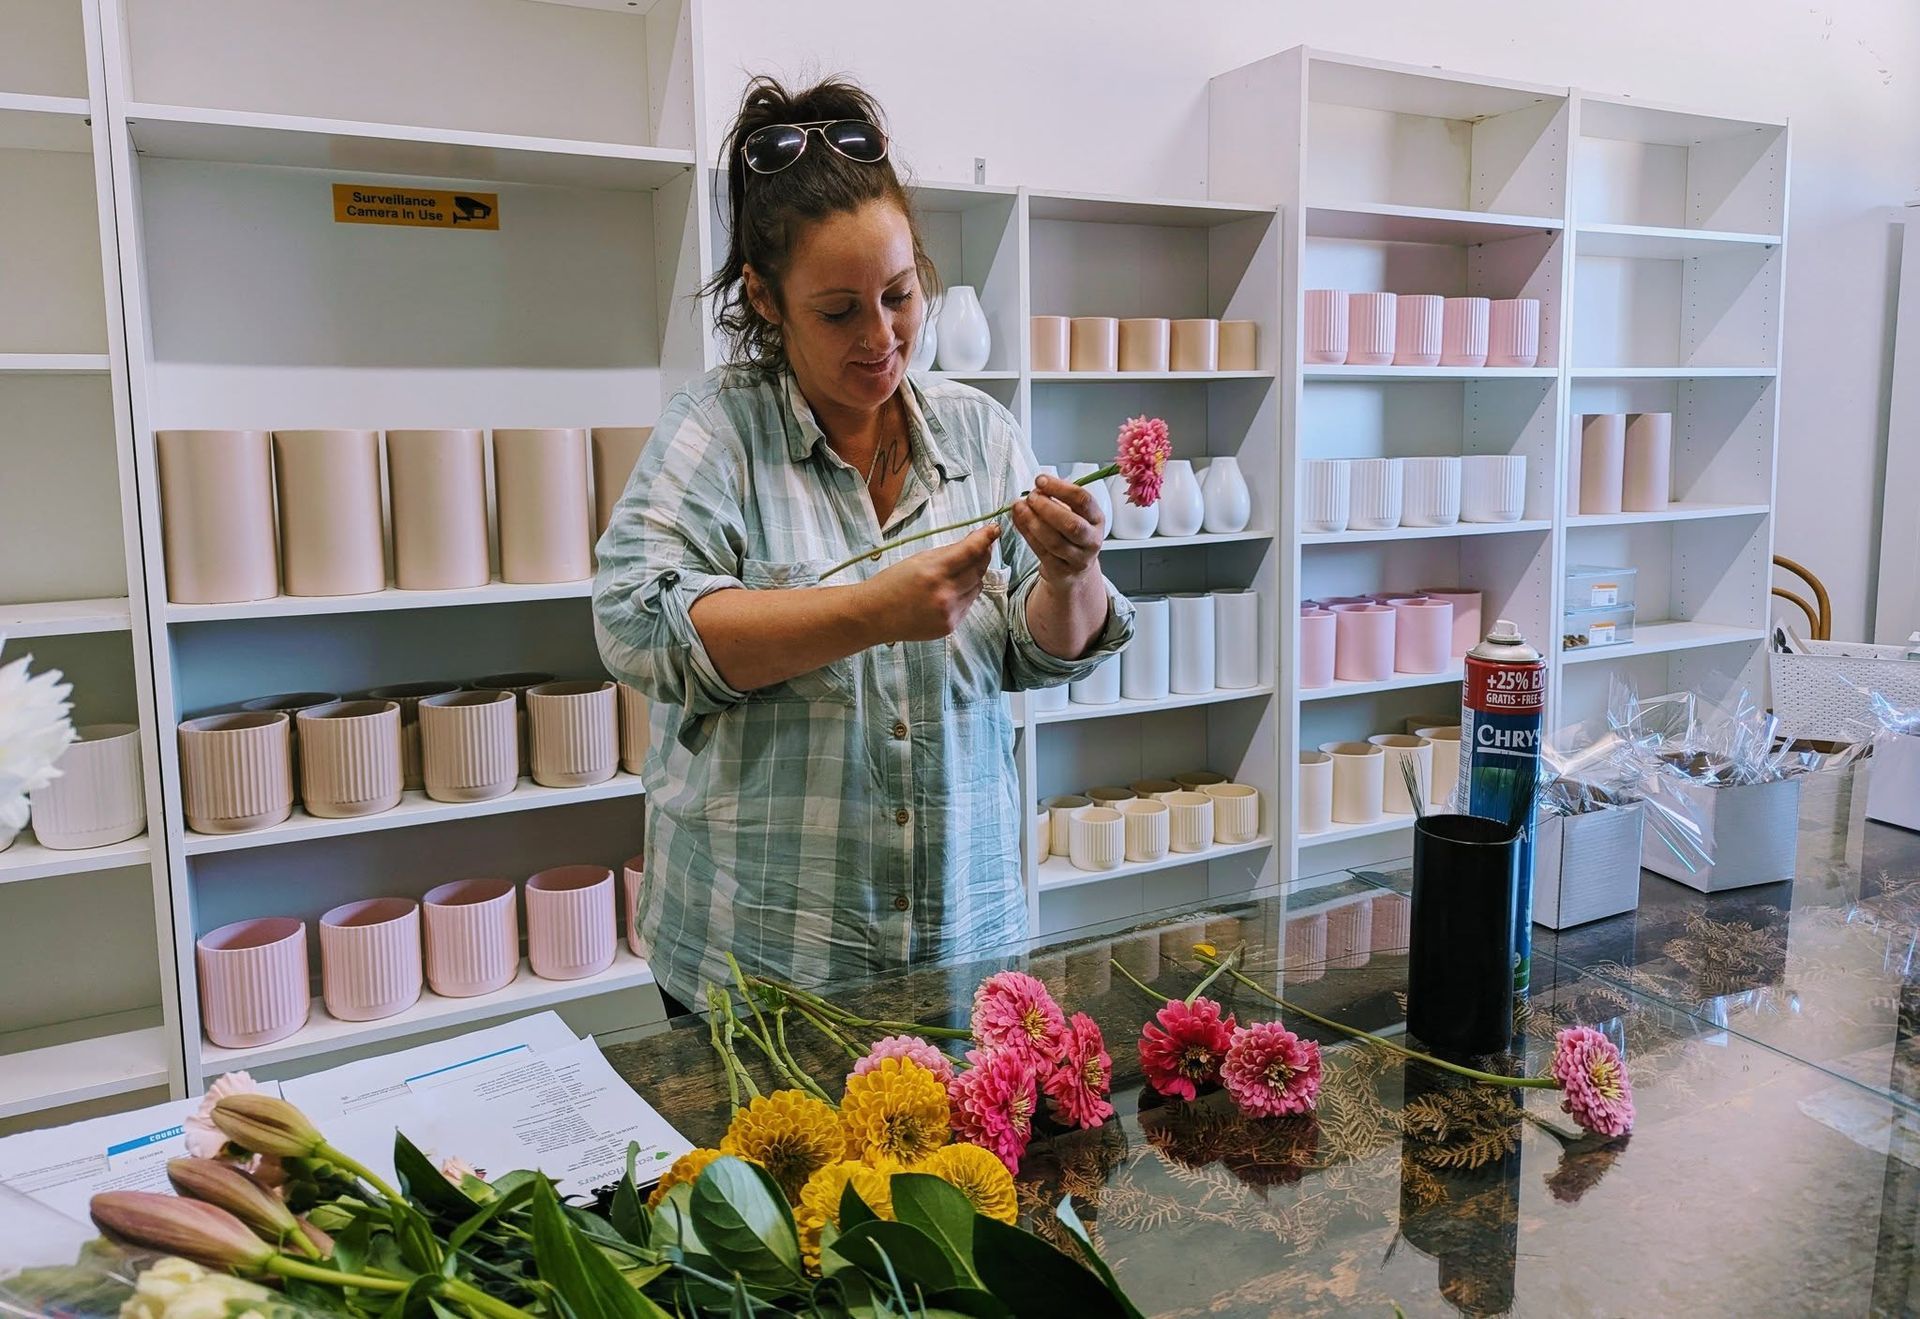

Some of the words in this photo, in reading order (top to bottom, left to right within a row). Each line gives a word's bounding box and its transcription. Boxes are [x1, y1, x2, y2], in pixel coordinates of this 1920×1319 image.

[352, 191, 436, 207] Surveillance
[346, 205, 399, 219] Camera
[402, 210, 415, 219] In
[418, 210, 444, 222] Use
[1487, 671, 1529, 690] +25%
[1486, 692, 1516, 705] GRATIS
[1521, 693, 1538, 705] FREE
